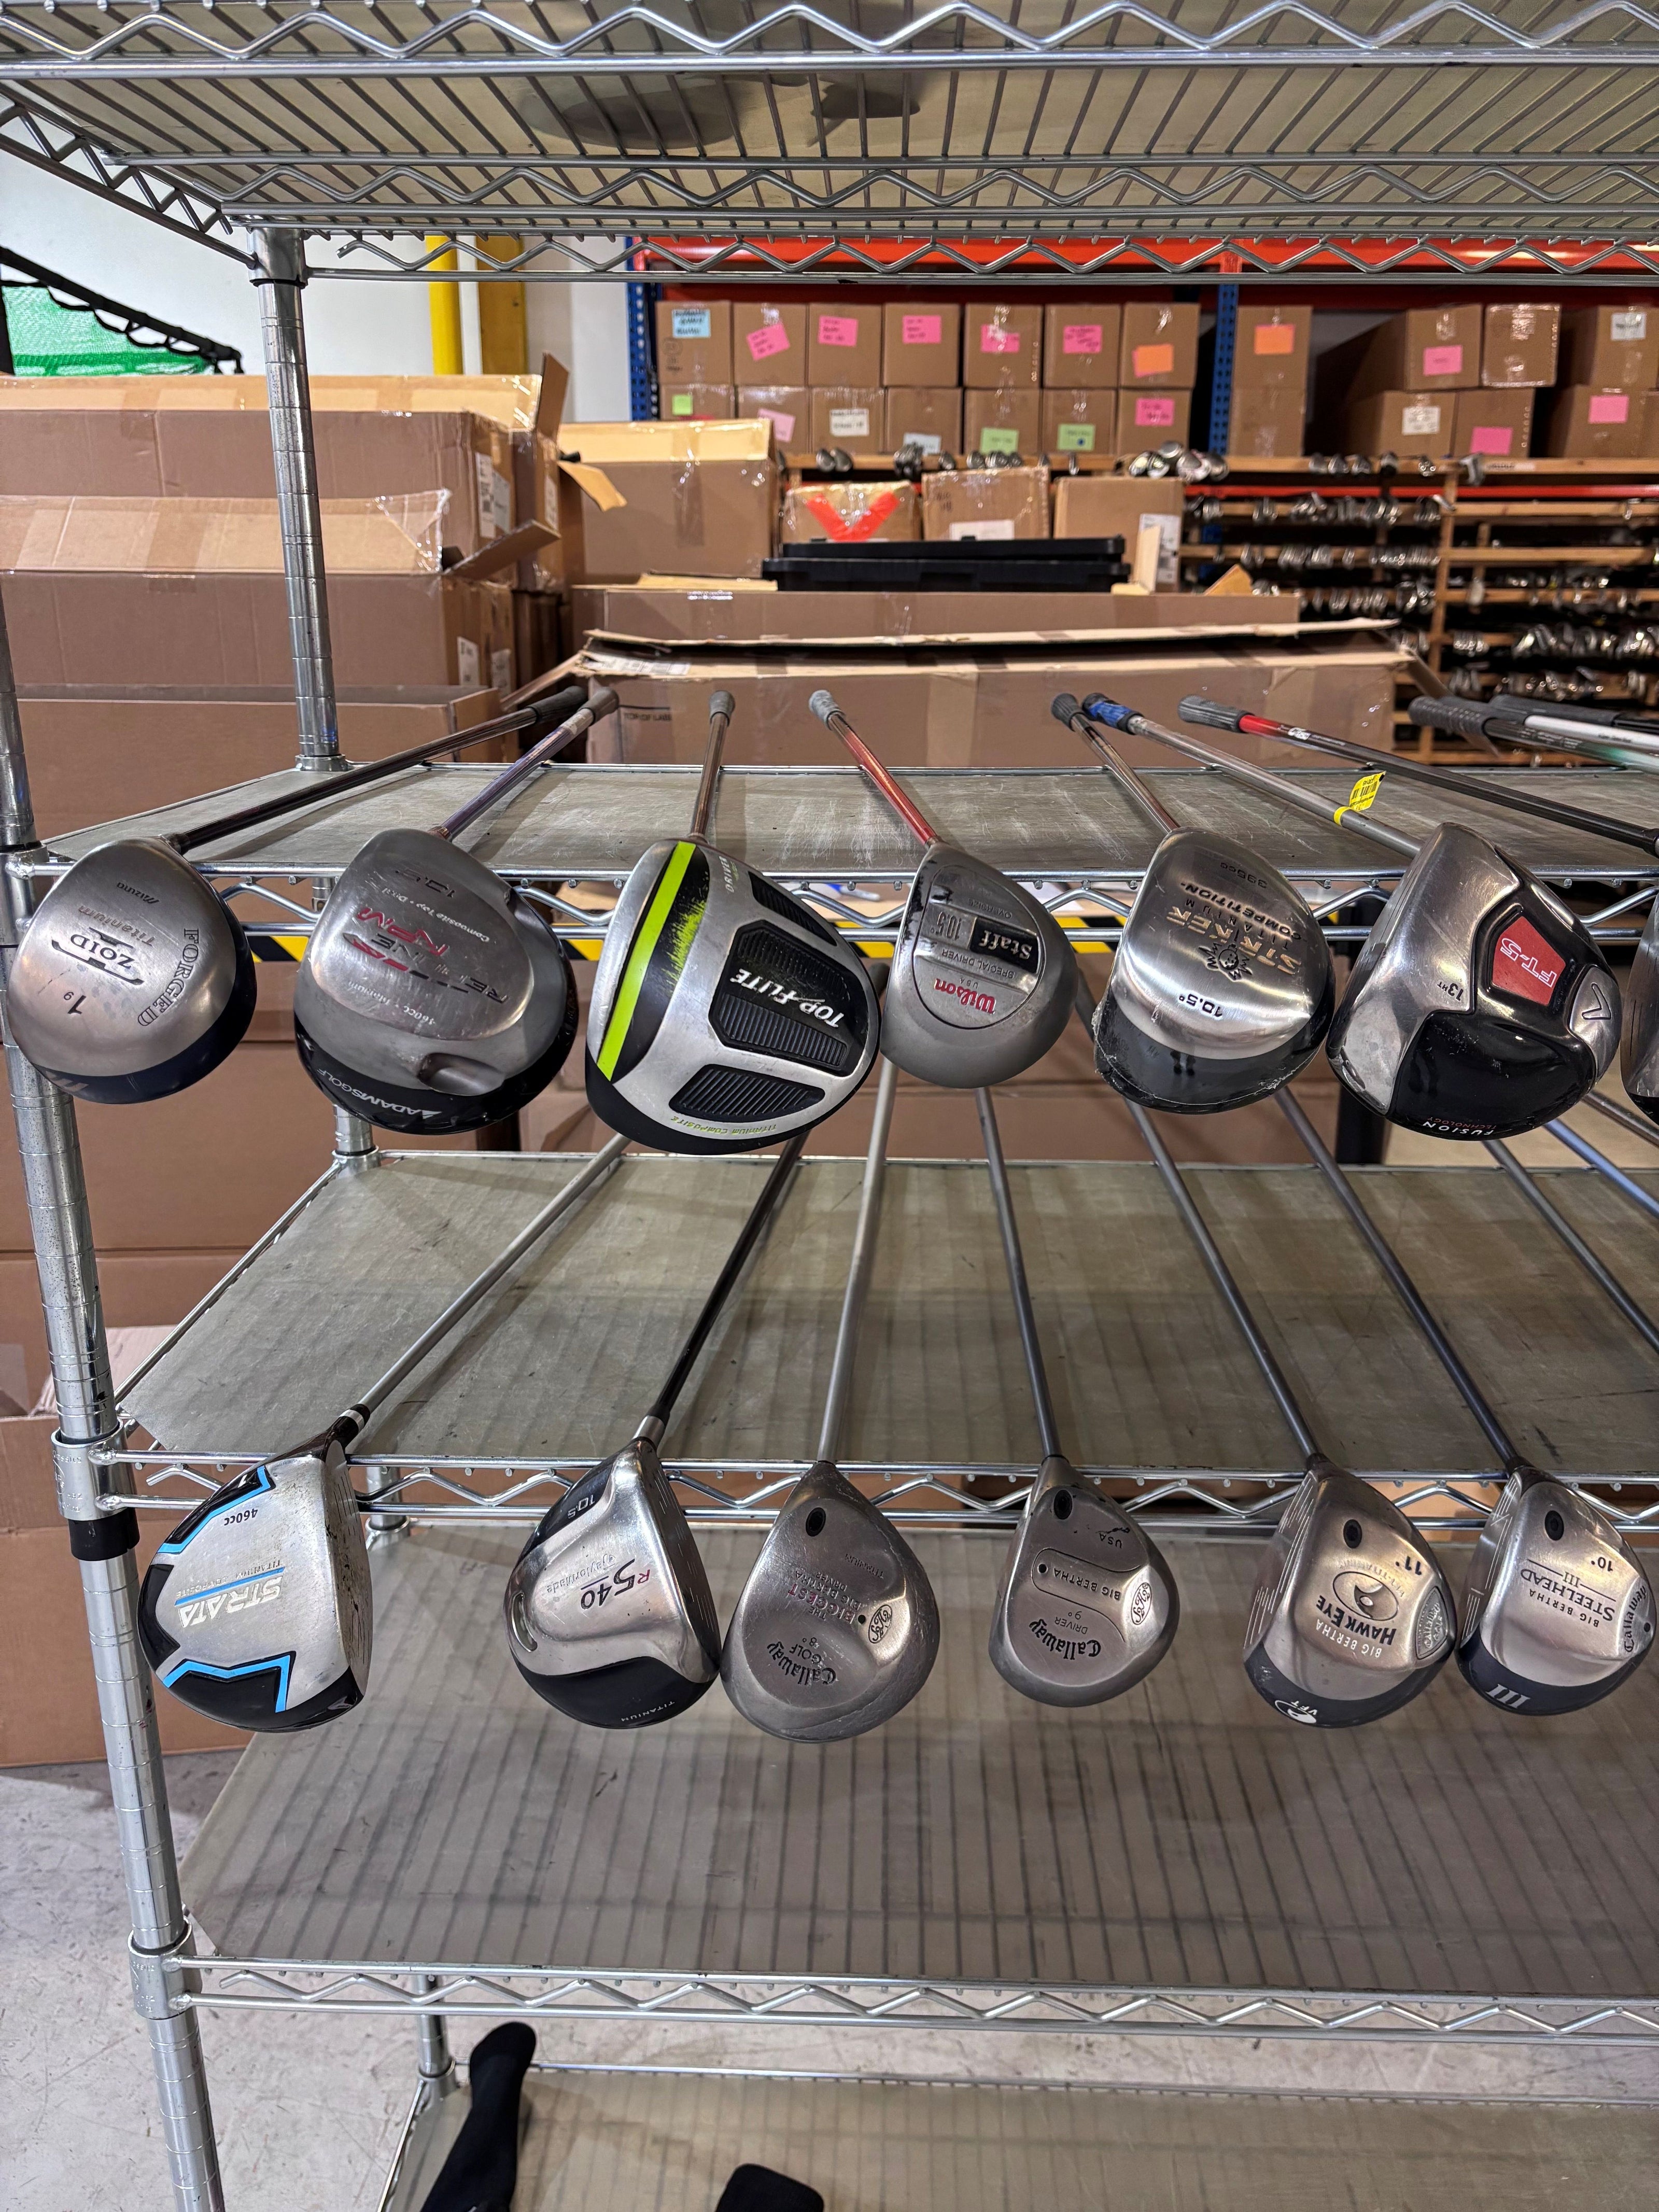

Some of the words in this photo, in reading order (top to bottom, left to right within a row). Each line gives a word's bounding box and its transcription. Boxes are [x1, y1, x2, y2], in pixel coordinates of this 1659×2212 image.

[78, 905, 156, 947] Titanium
[70, 933, 136, 969] ZOID
[978, 930, 1032, 960] Staff
[941, 948, 980, 967] DRIVER
[1500, 938, 1558, 988] FT-5
[137, 928, 200, 1027] FORGED
[980, 960, 1015, 979] SPECIAL
[934, 978, 996, 1015] Wilson
[670, 1116, 728, 1135] COMPOSITE
[732, 1123, 777, 1135] TITANIUM
[1423, 1120, 1495, 1136] FUSION
[1427, 1117, 1497, 1130] TECHNOLOGY
[223, 1508, 258, 1526] 460cc
[1099, 1532, 1123, 1549] USA
[235, 1559, 281, 1579] TITANIUM
[845, 1553, 884, 1579] TITANIUM
[817, 1570, 847, 1592] DRIVER
[1053, 1568, 1098, 1592] BERTHA
[178, 1576, 283, 1628] STRATA
[1102, 1584, 1121, 1600] BIG
[1520, 1568, 1616, 1623] STEELHEAD
[1529, 1588, 1573, 1615] BERTHA
[788, 1583, 856, 1625] BIGGEST
[808, 1606, 827, 1622] THE
[1055, 1616, 1088, 1635] DRIVER
[1579, 1613, 1600, 1628] BIG
[1624, 1585, 1648, 1654] Callaway
[1029, 1618, 1102, 1660] Callaway
[1315, 1618, 1357, 1651] BERTHA
[790, 1643, 822, 1666] GOLF
[1361, 1644, 1382, 1658] BIG
[766, 1641, 839, 1687] Callaway
[621, 1700, 676, 1723] TITANIUM
[1291, 1700, 1318, 1715] VFT
